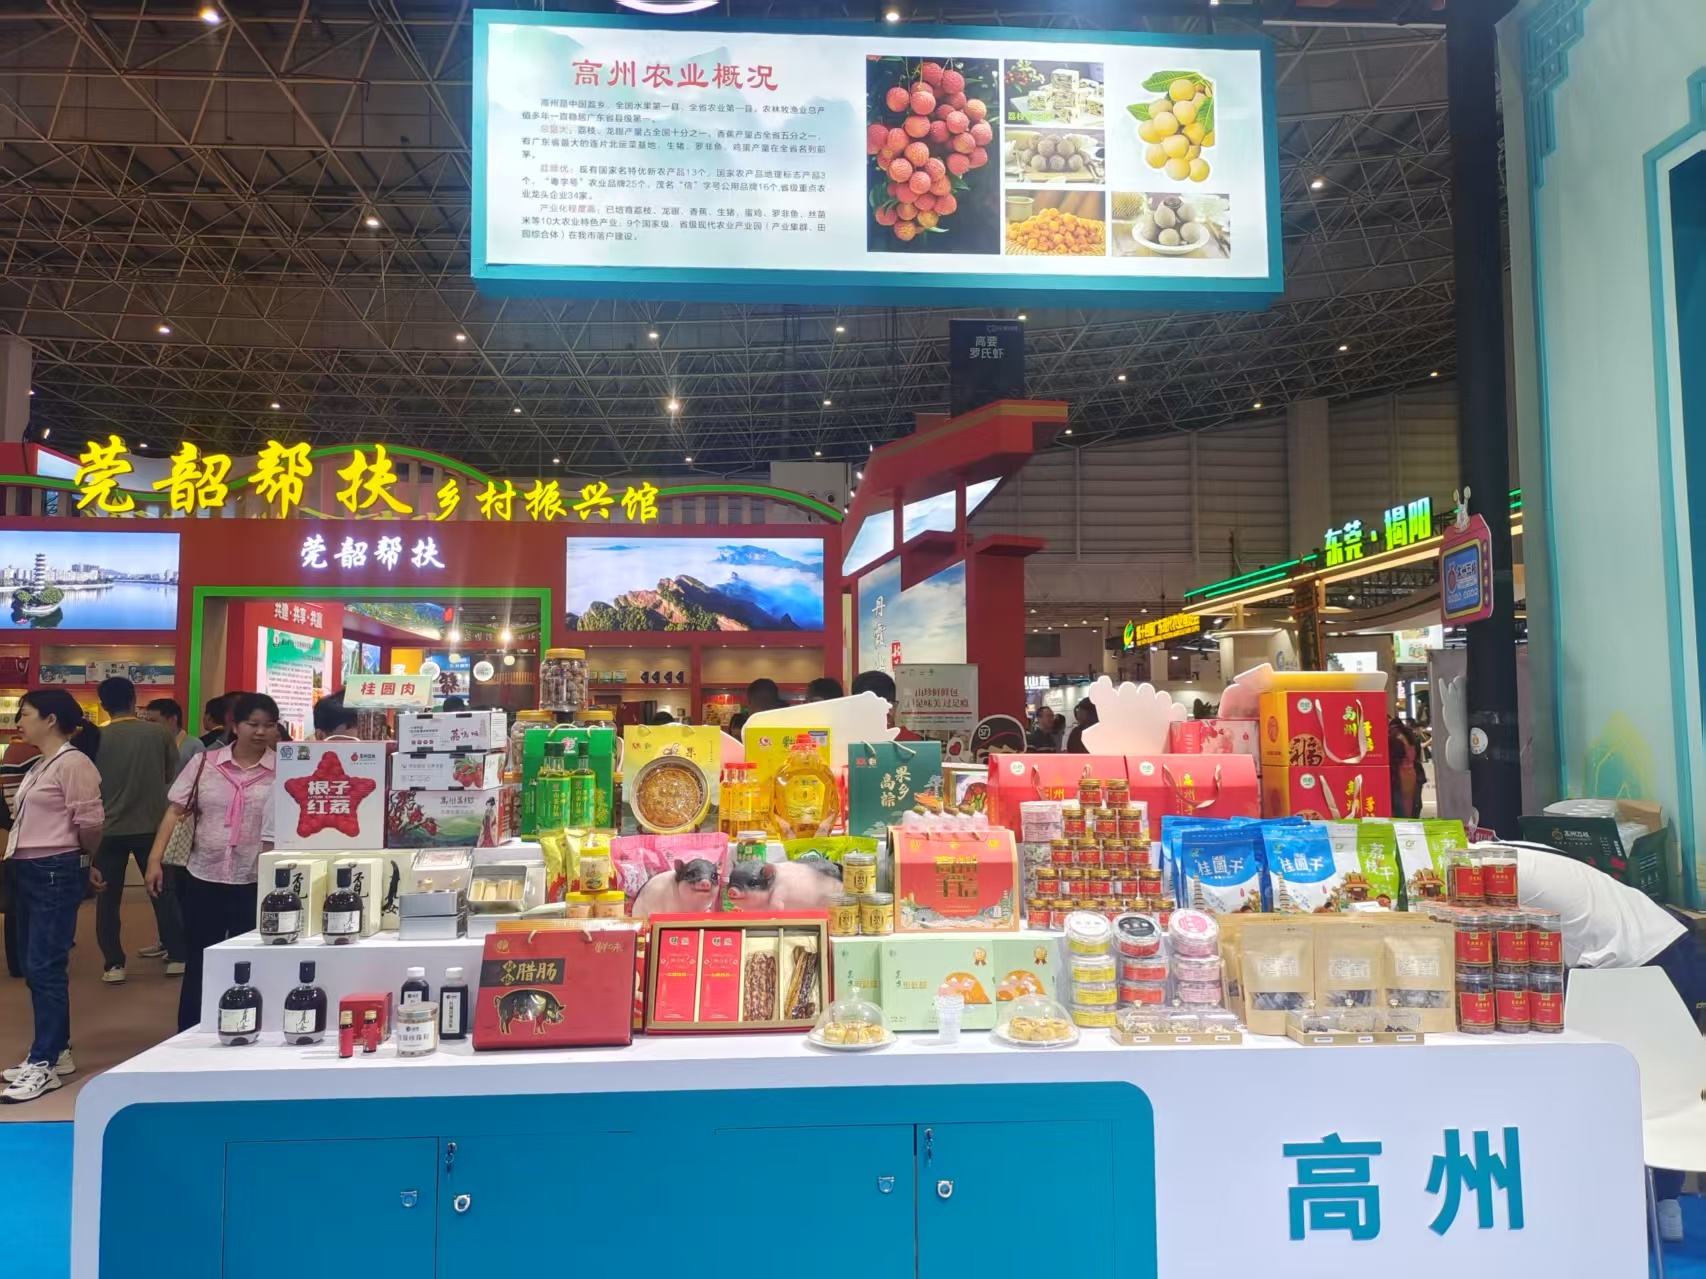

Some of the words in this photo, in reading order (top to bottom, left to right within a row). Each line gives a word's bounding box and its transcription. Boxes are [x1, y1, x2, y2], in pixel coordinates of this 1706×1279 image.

[572, 59, 778, 92] 高州农业概况
[73, 434, 413, 518] 莞韶帮扶
[435, 478, 659, 523] 乡村振兴馆
[1324, 497, 1432, 567] 东莞·揭阳
[301, 534, 445, 570] 莞韶帮扶
[361, 682, 416, 696] 桂圆肉
[308, 781, 351, 795] 根子
[1194, 855, 1244, 876] 桂圆干
[516, 961, 557, 982] 腊肠
[1283, 1126, 1524, 1241] 高州
